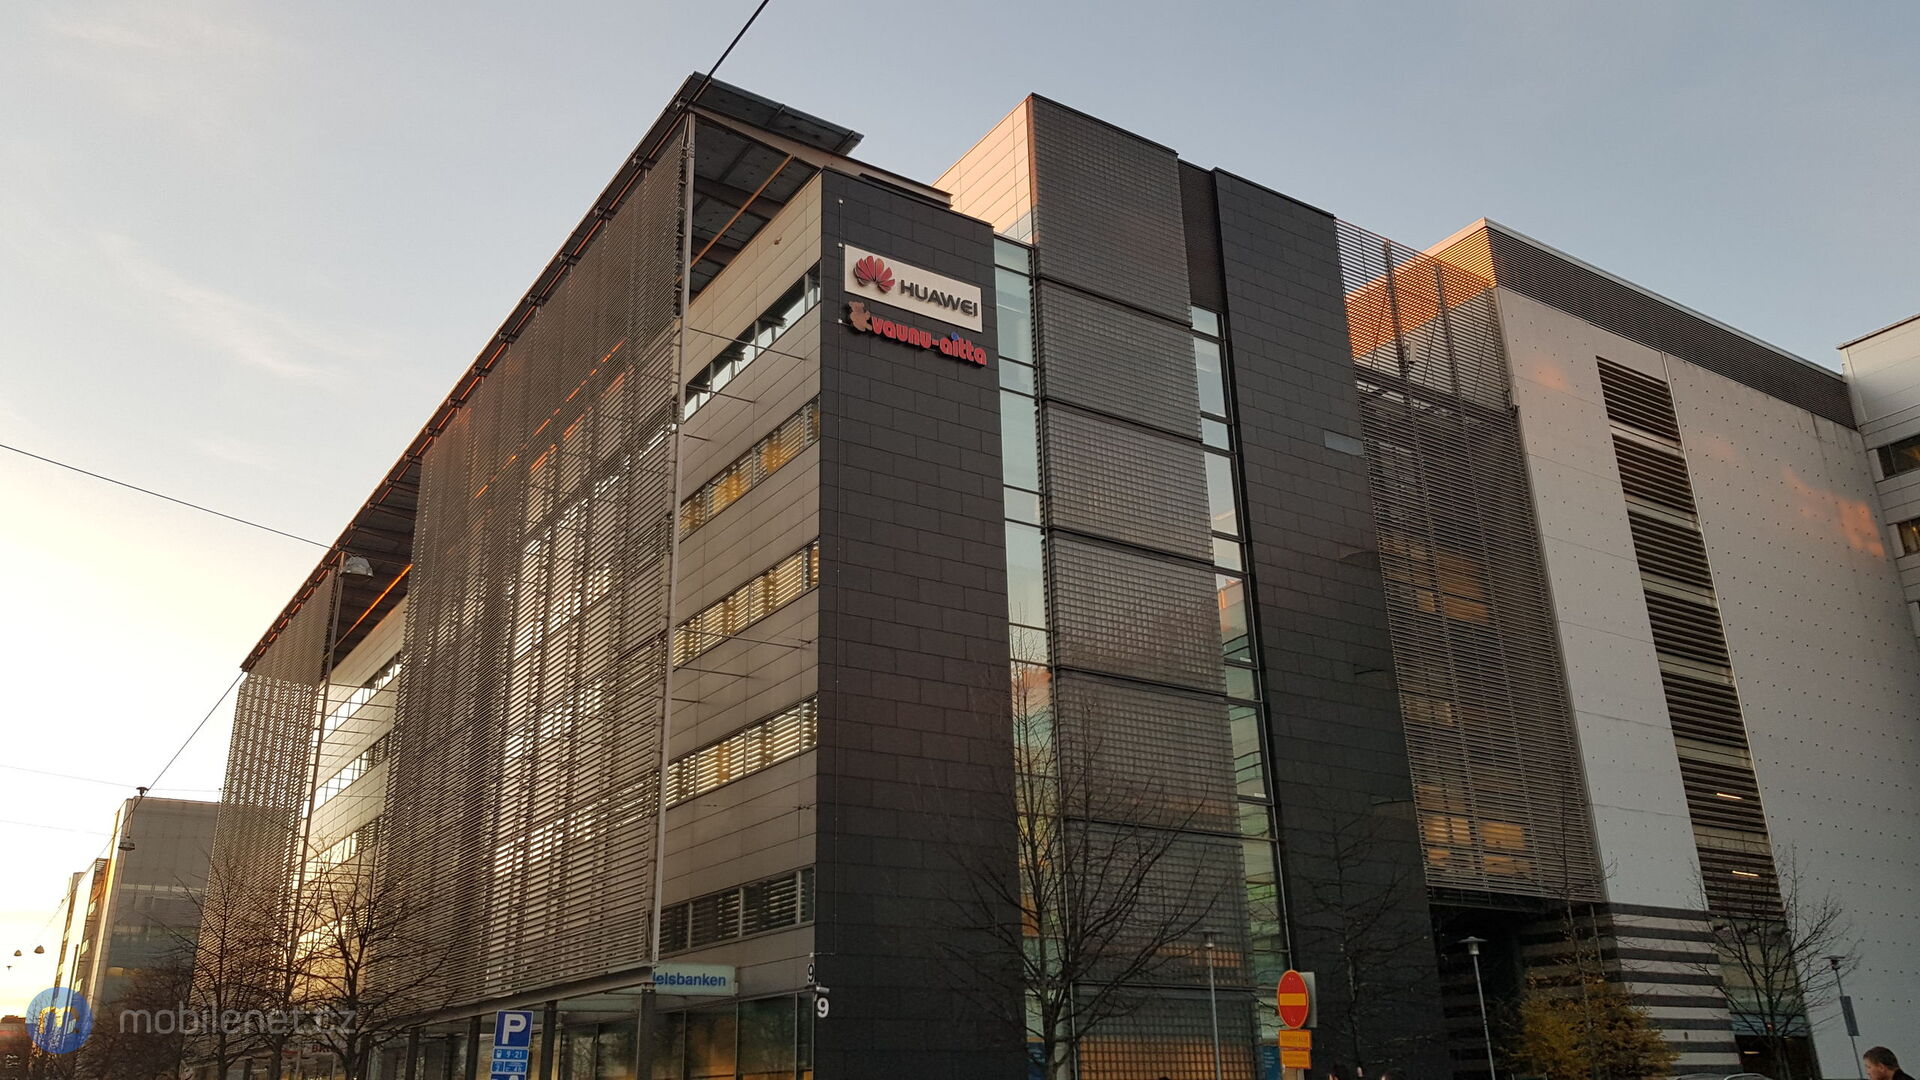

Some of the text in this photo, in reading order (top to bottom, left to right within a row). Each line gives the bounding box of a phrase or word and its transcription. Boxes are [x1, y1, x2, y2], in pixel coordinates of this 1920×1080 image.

[900, 279, 978, 317] HUAWEI
[871, 316, 987, 365] vaunu-aitta
[808, 964, 815, 983] 9
[817, 997, 830, 1018] 9
[502, 1014, 527, 1045] P
